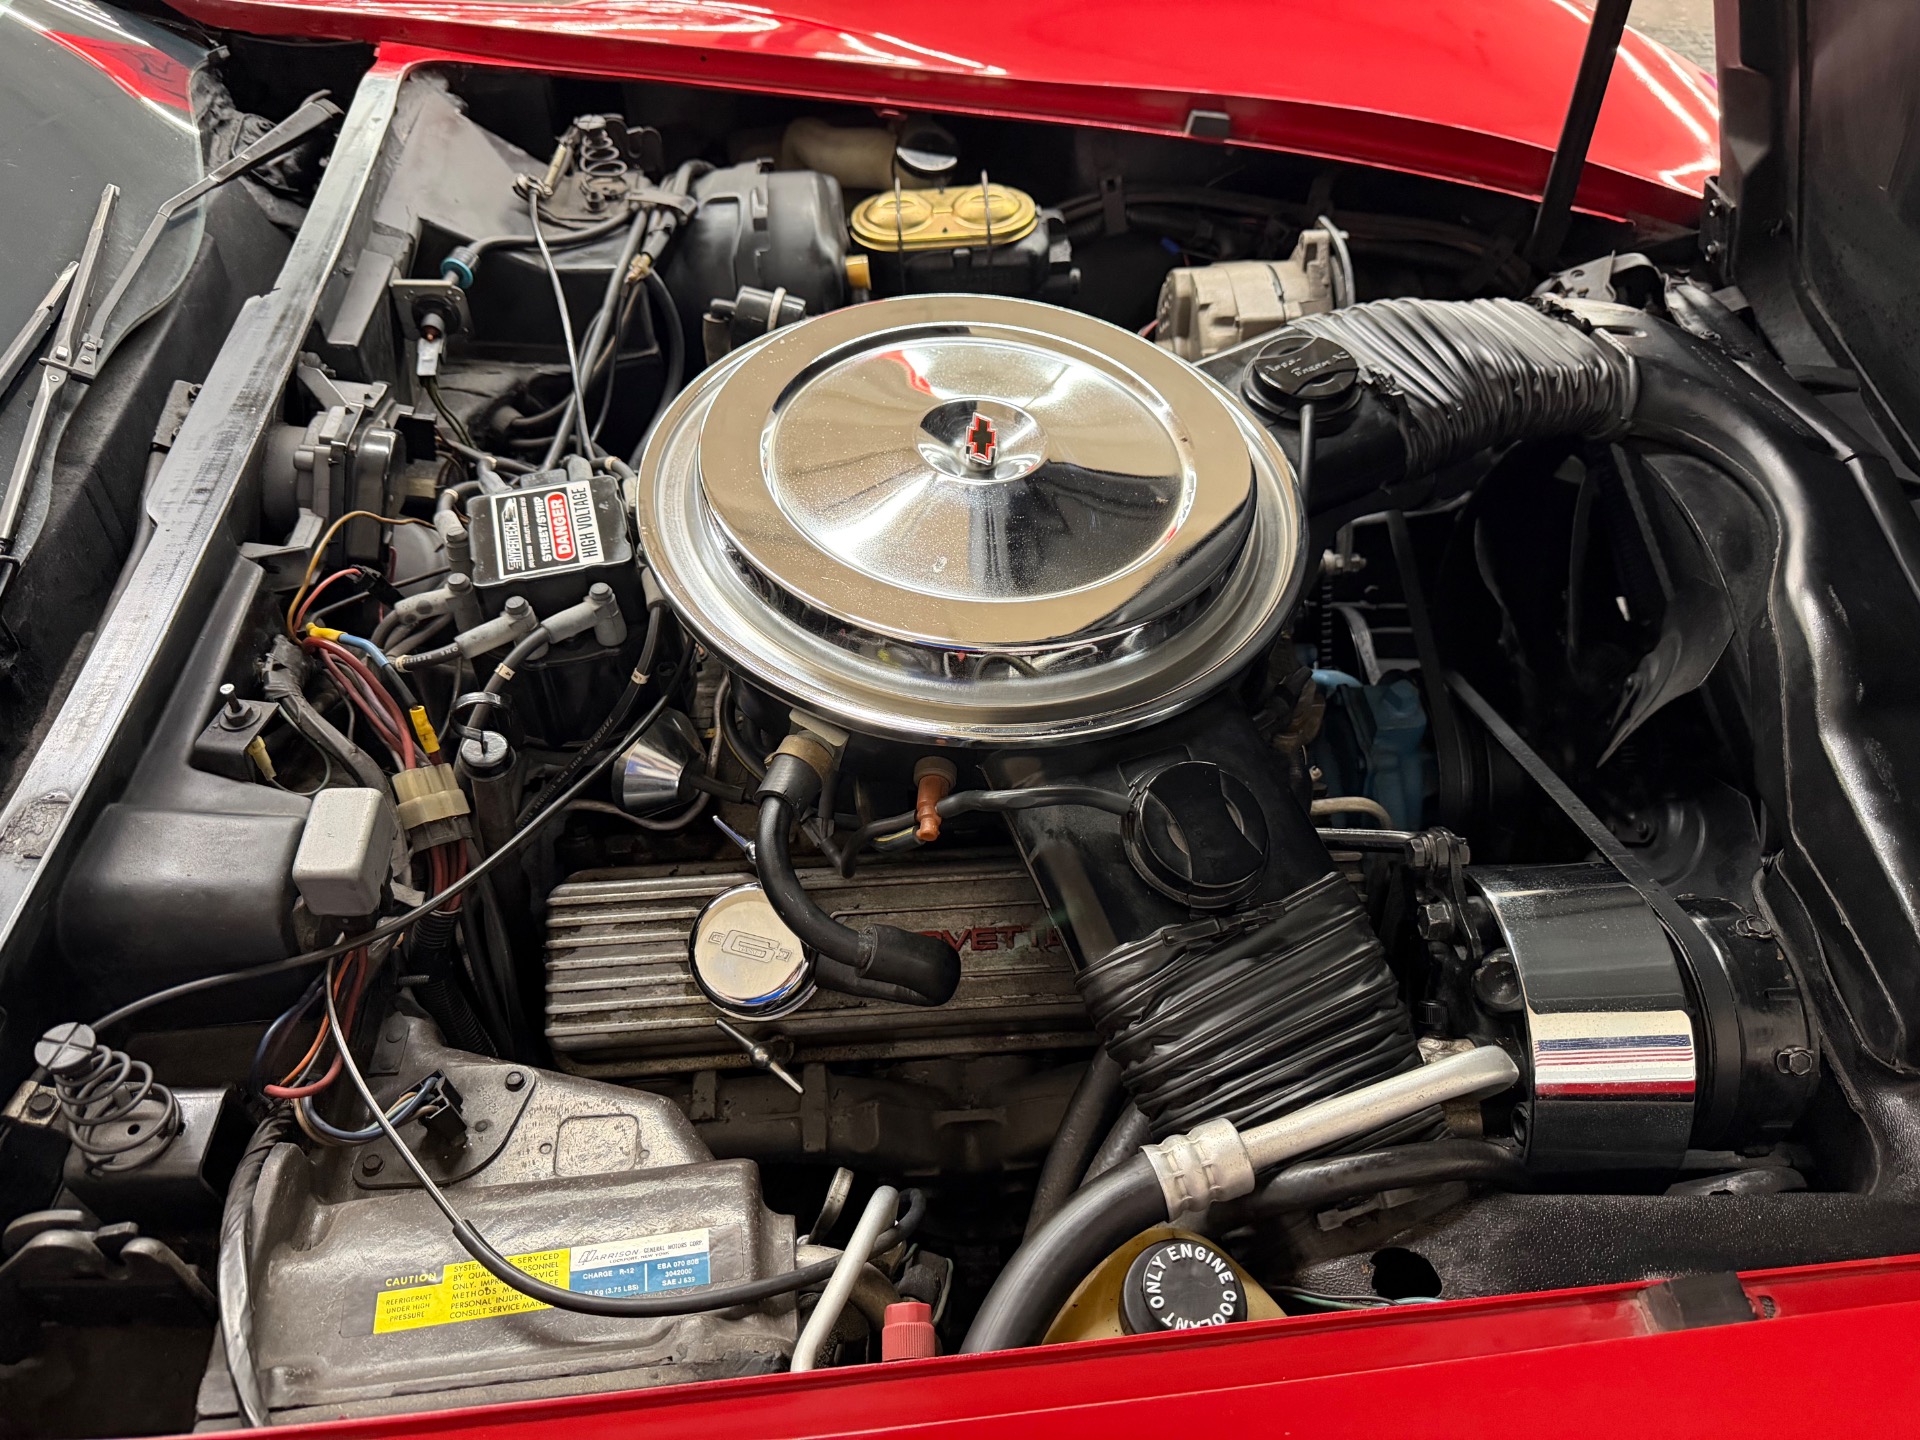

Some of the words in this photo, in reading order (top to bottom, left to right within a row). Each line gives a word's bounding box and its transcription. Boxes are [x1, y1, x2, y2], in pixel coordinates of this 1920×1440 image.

[571, 487, 592, 530] VOLTAGE
[532, 496, 552, 562] STREET/STRIP
[550, 498, 572, 556] DANGER
[502, 520, 523, 569] HYPERTECH
[579, 530, 599, 558] HIGH
[594, 715, 613, 743] TAYLOR
[643, 1245, 665, 1254] GENERAL
[667, 1242, 688, 1250] MOTORS
[518, 1253, 559, 1263] SERVICED
[657, 1262, 672, 1270] EBA
[673, 1260, 686, 1268] 070
[453, 1273, 464, 1282] BY
[519, 1262, 559, 1272] RSONNEL
[582, 1270, 613, 1280] CHARGE
[619, 1267, 635, 1275] R-12
[664, 1268, 693, 1278] 3042000
[1146, 1256, 1167, 1309] ONLY
[1166, 1244, 1235, 1285] ENGINE
[385, 1272, 437, 1287] CAUTION
[661, 1278, 677, 1286] SAE
[683, 1276, 696, 1284] 639
[452, 1282, 477, 1291] ONLY.
[604, 1286, 622, 1295] (3.75
[623, 1284, 639, 1292] LBS)
[385, 1293, 432, 1306] REFRIGERANT
[451, 1287, 497, 1300] METHODS
[450, 1297, 491, 1310] PERSONAL
[495, 1293, 527, 1303] INJURY.
[386, 1305, 410, 1314] UNDER
[449, 1307, 487, 1319] CONSULT
[488, 1303, 520, 1313] SERVICE
[389, 1311, 425, 1322] PRESSURE
